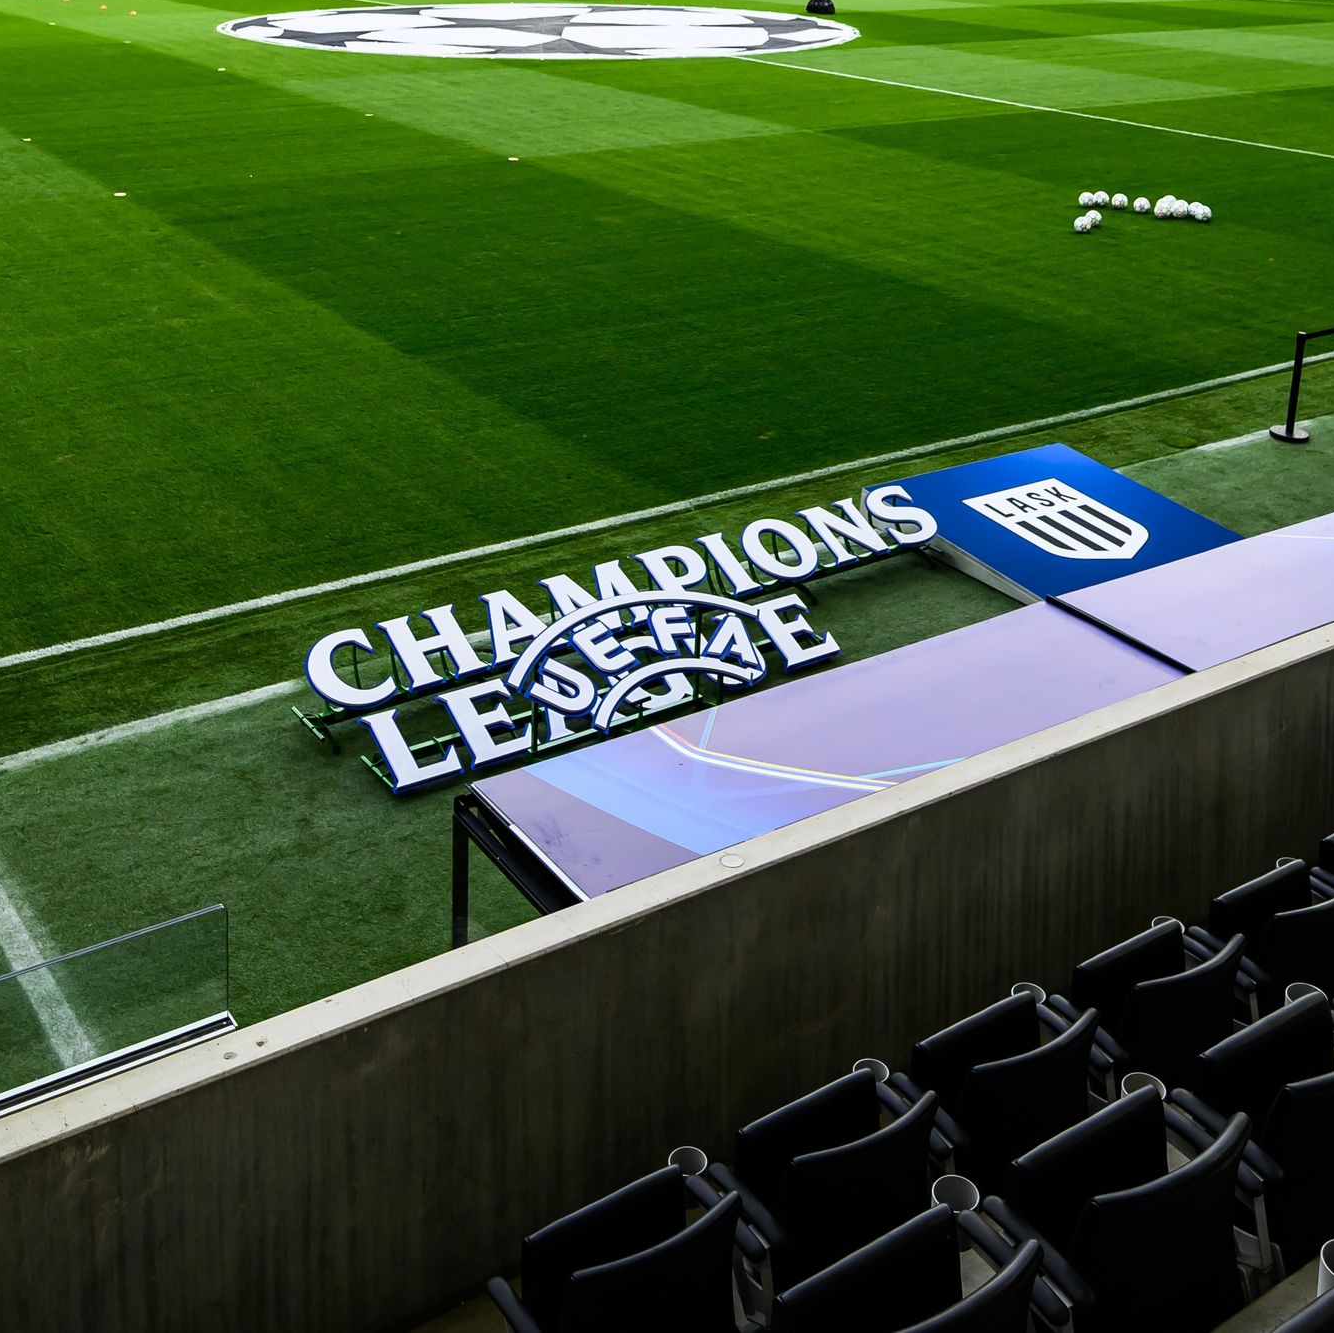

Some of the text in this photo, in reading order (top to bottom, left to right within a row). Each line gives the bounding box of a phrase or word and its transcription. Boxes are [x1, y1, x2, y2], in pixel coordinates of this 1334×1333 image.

[983, 486, 1078, 518] LASK
[305, 484, 939, 709] CHAMPIONS
[525, 605, 763, 717] UEFA
